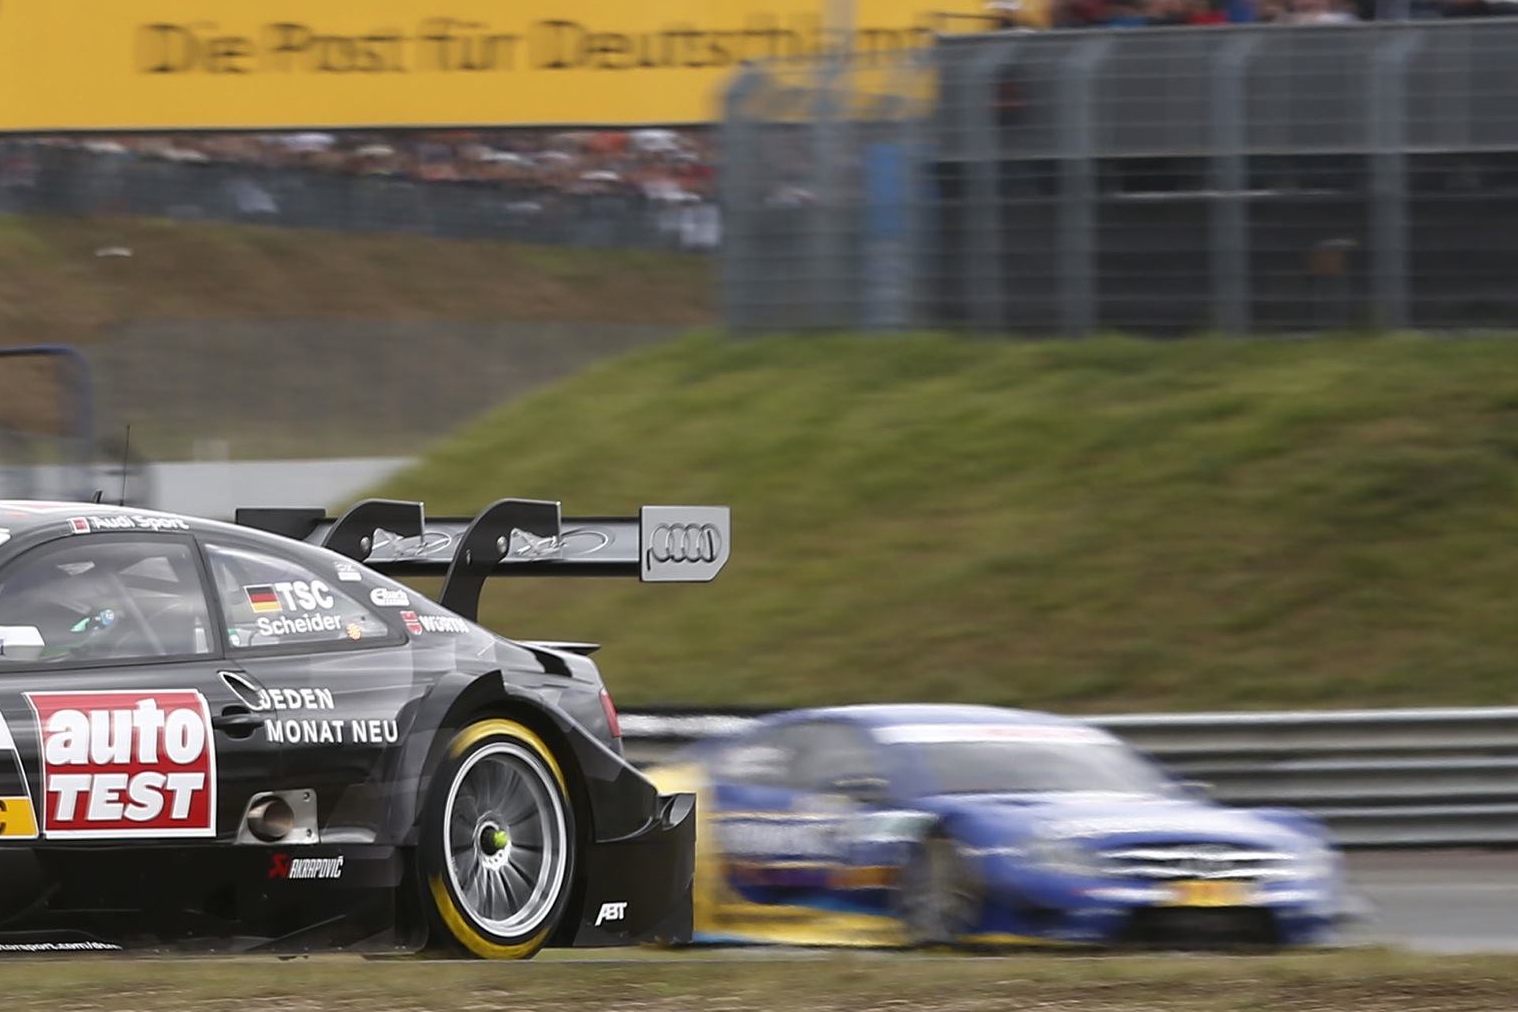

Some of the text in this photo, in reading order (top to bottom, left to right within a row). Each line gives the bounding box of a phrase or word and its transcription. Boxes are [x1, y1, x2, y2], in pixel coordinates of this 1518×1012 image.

[270, 22, 406, 73] Post
[88, 515, 190, 531] Audi Sport
[274, 580, 334, 611] TSC
[257, 613, 342, 636] Scheider
[259, 688, 335, 710] JEDEN
[45, 698, 204, 765] auto
[265, 719, 399, 743] MONAT NEU
[48, 771, 204, 821] TEST
[595, 902, 628, 926] ABT
